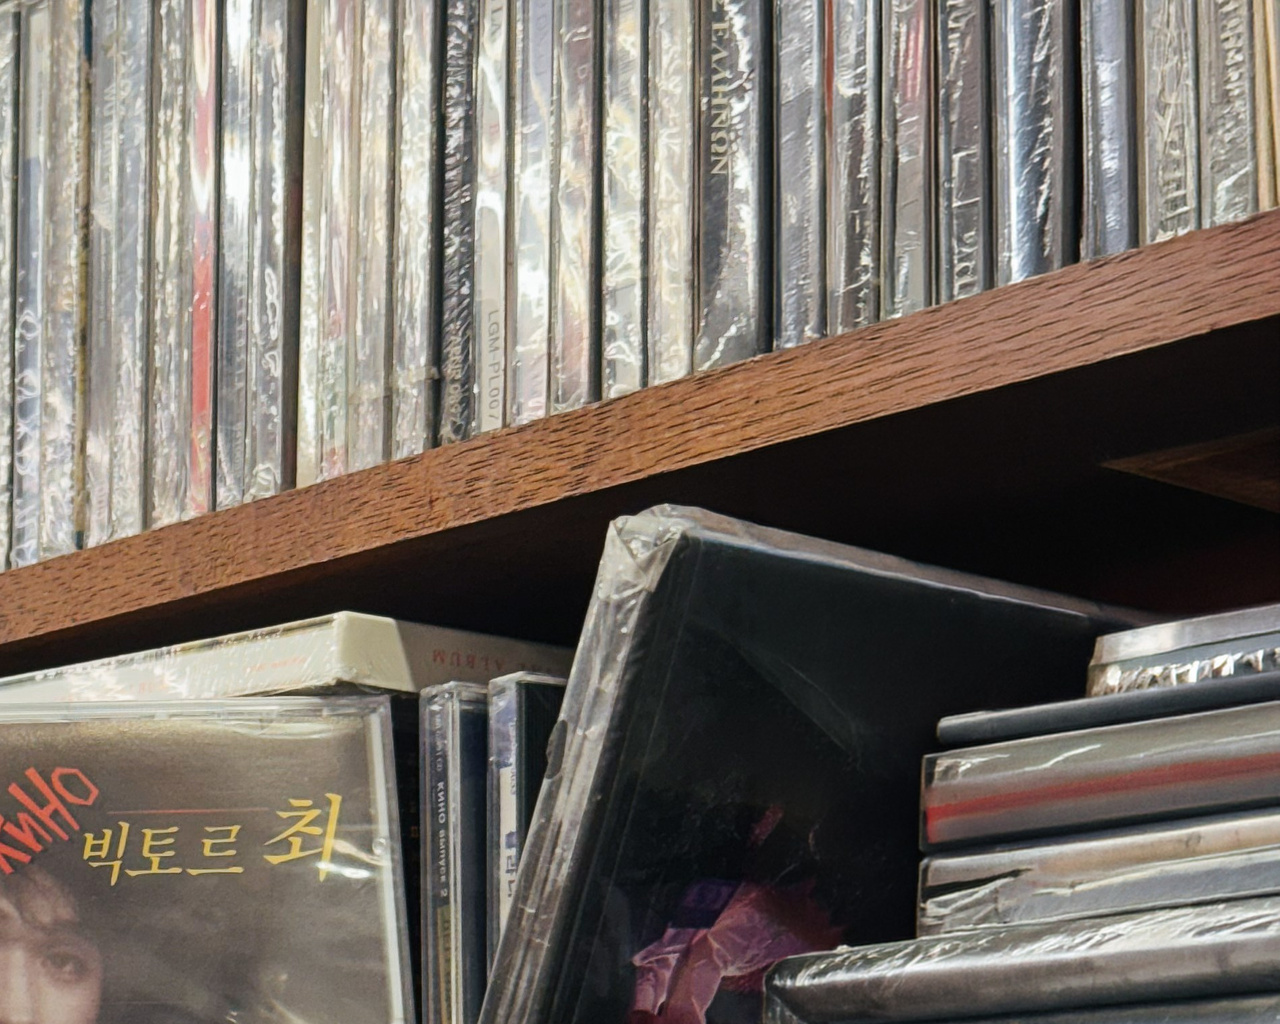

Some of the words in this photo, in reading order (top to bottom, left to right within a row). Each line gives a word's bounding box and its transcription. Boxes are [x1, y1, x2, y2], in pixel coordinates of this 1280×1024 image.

[435, 781, 446, 825] КИНО
[82, 820, 245, 887] 빅토르
[262, 793, 343, 883] 최
